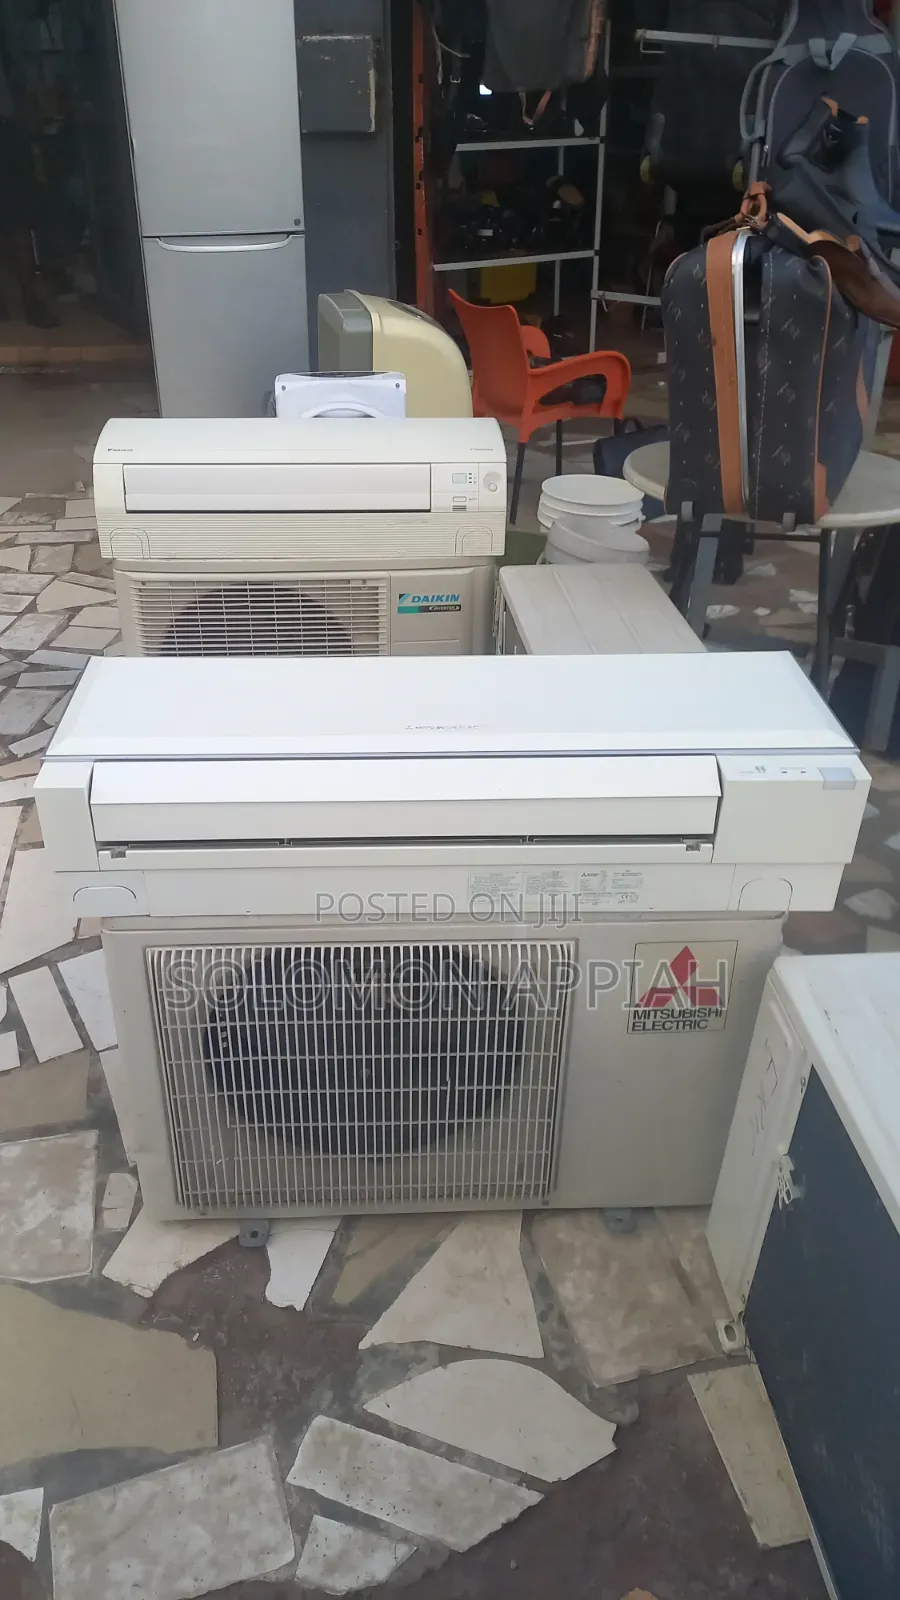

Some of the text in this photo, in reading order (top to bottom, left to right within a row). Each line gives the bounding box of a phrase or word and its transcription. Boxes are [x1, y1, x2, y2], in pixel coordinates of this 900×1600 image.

[411, 594, 460, 603] DAIKIN
[632, 1007, 723, 1021] MITSUBISHI
[631, 1018, 709, 1032] ELECTRIC
